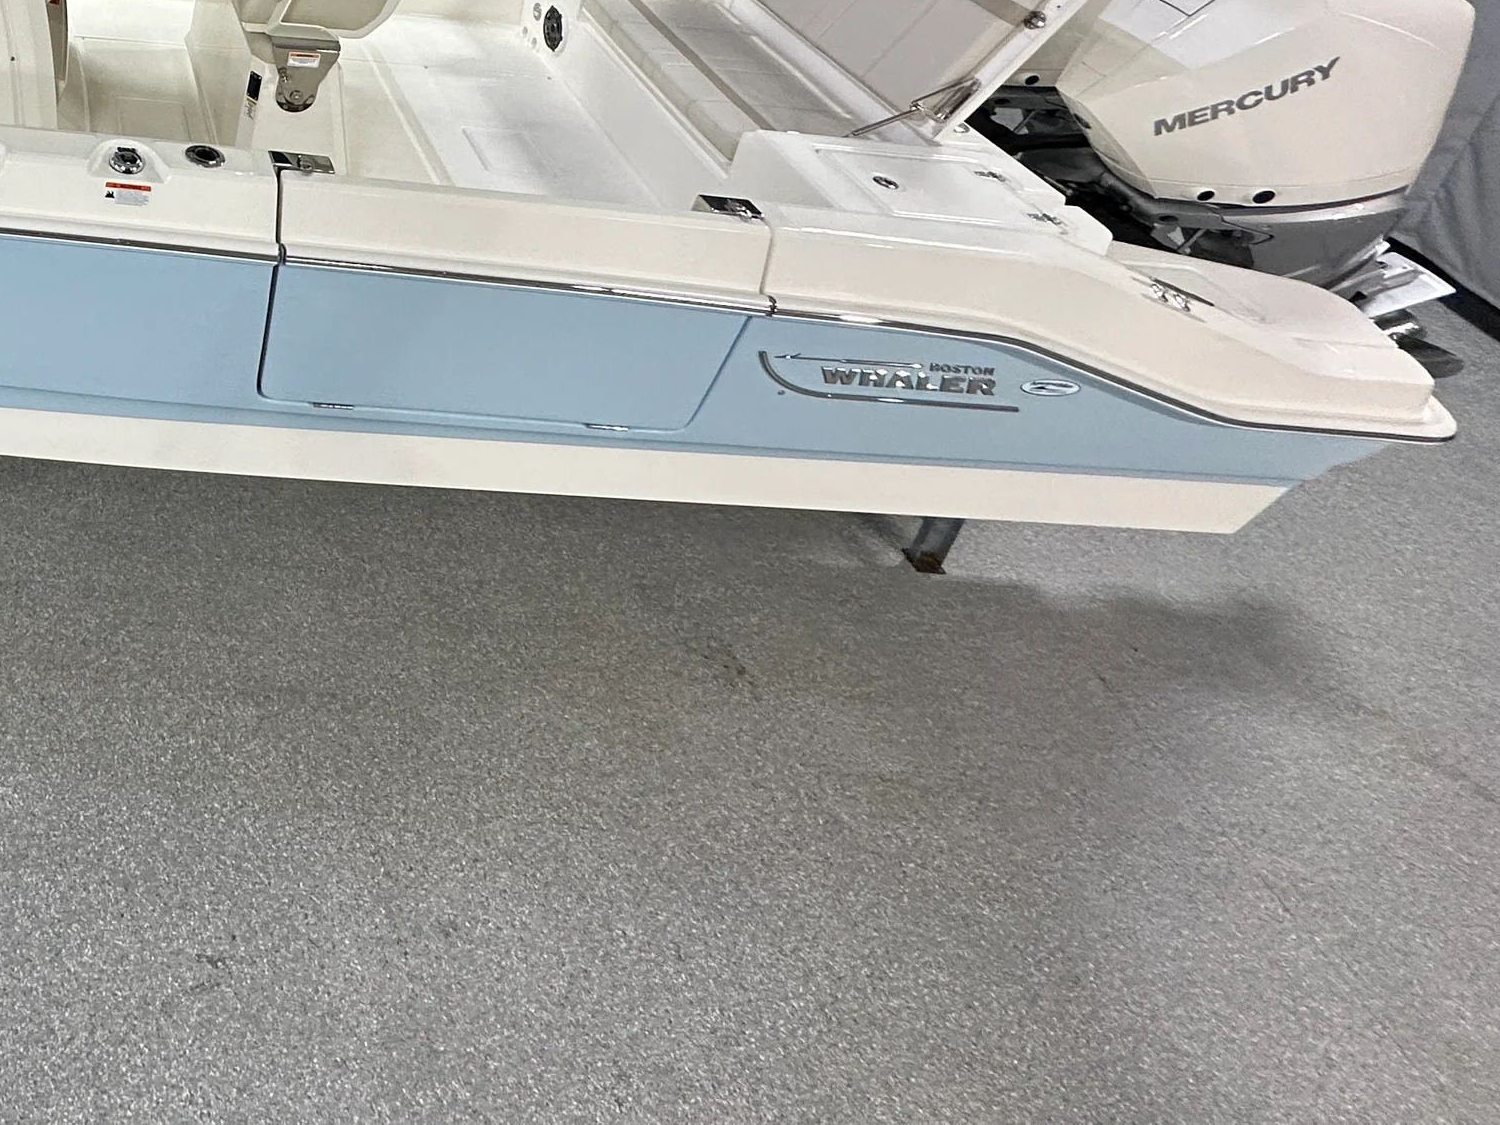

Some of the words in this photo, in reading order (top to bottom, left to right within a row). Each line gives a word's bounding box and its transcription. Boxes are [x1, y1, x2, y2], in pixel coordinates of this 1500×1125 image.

[1153, 56, 1341, 136] MERCURY
[821, 366, 997, 396] WHALER
[929, 362, 995, 376] BOSTON
